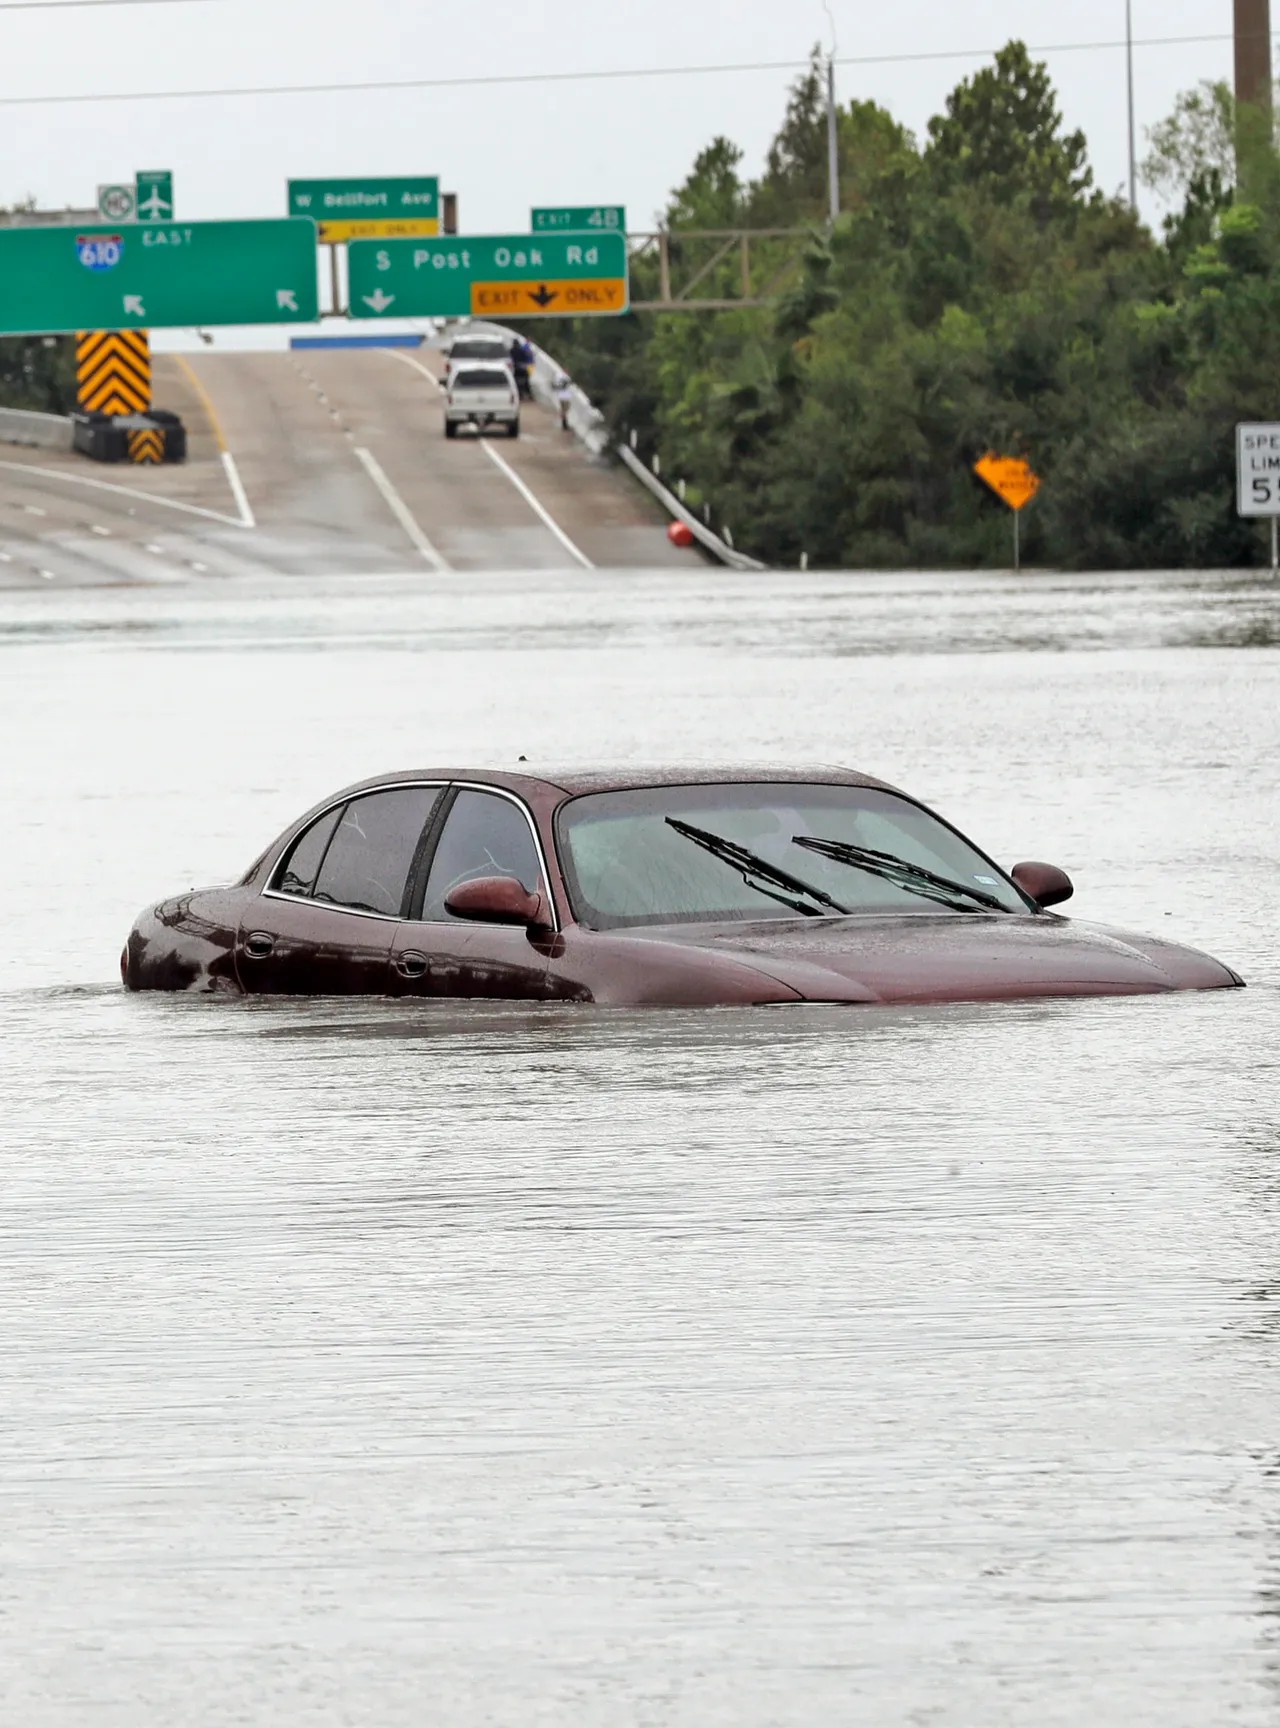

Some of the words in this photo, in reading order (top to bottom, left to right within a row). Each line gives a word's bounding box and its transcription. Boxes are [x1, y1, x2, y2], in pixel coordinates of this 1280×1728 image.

[296, 194, 312, 206] W
[324, 192, 388, 206] Bellfort
[401, 192, 432, 205] Ave
[142, 229, 192, 247] EAST
[79, 242, 120, 266] 610
[376, 250, 391, 270] S
[414, 248, 470, 269] Post
[494, 247, 543, 267] Oak
[567, 245, 598, 265] Rd
[478, 290, 519, 306] EXIT
[565, 287, 616, 303] ONLY
[1253, 478, 1280, 504] 5
